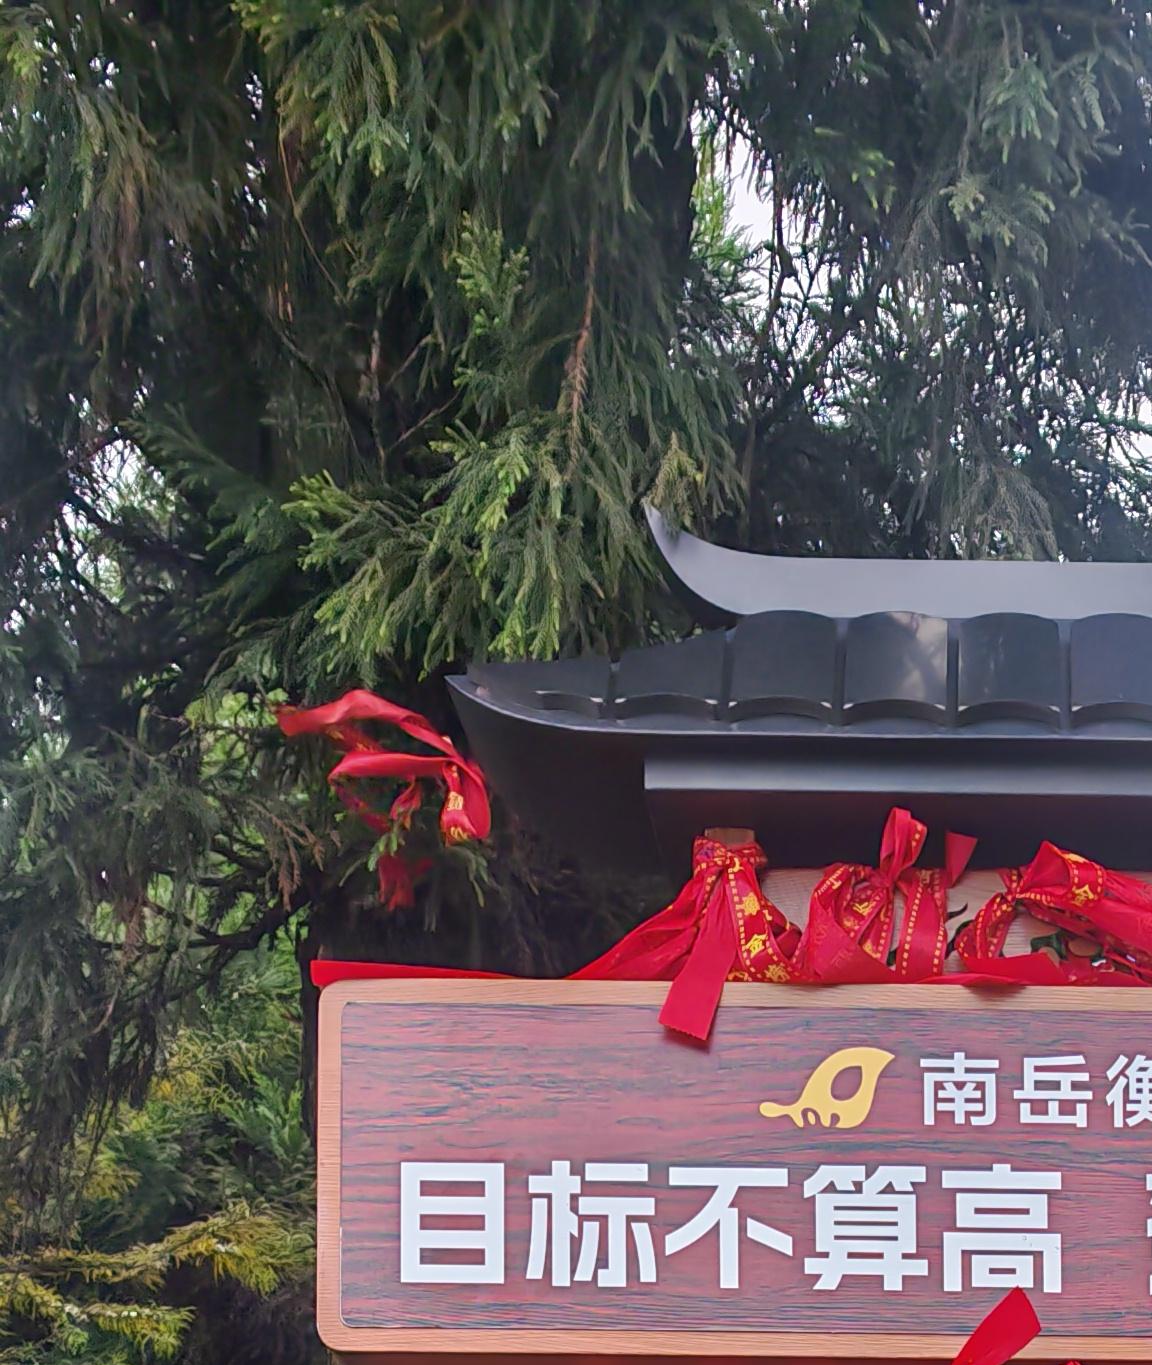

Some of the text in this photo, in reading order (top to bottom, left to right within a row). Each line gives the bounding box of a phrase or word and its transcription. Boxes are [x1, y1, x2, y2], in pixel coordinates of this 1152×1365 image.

[400, 1160, 1062, 1294] 目标不算高
